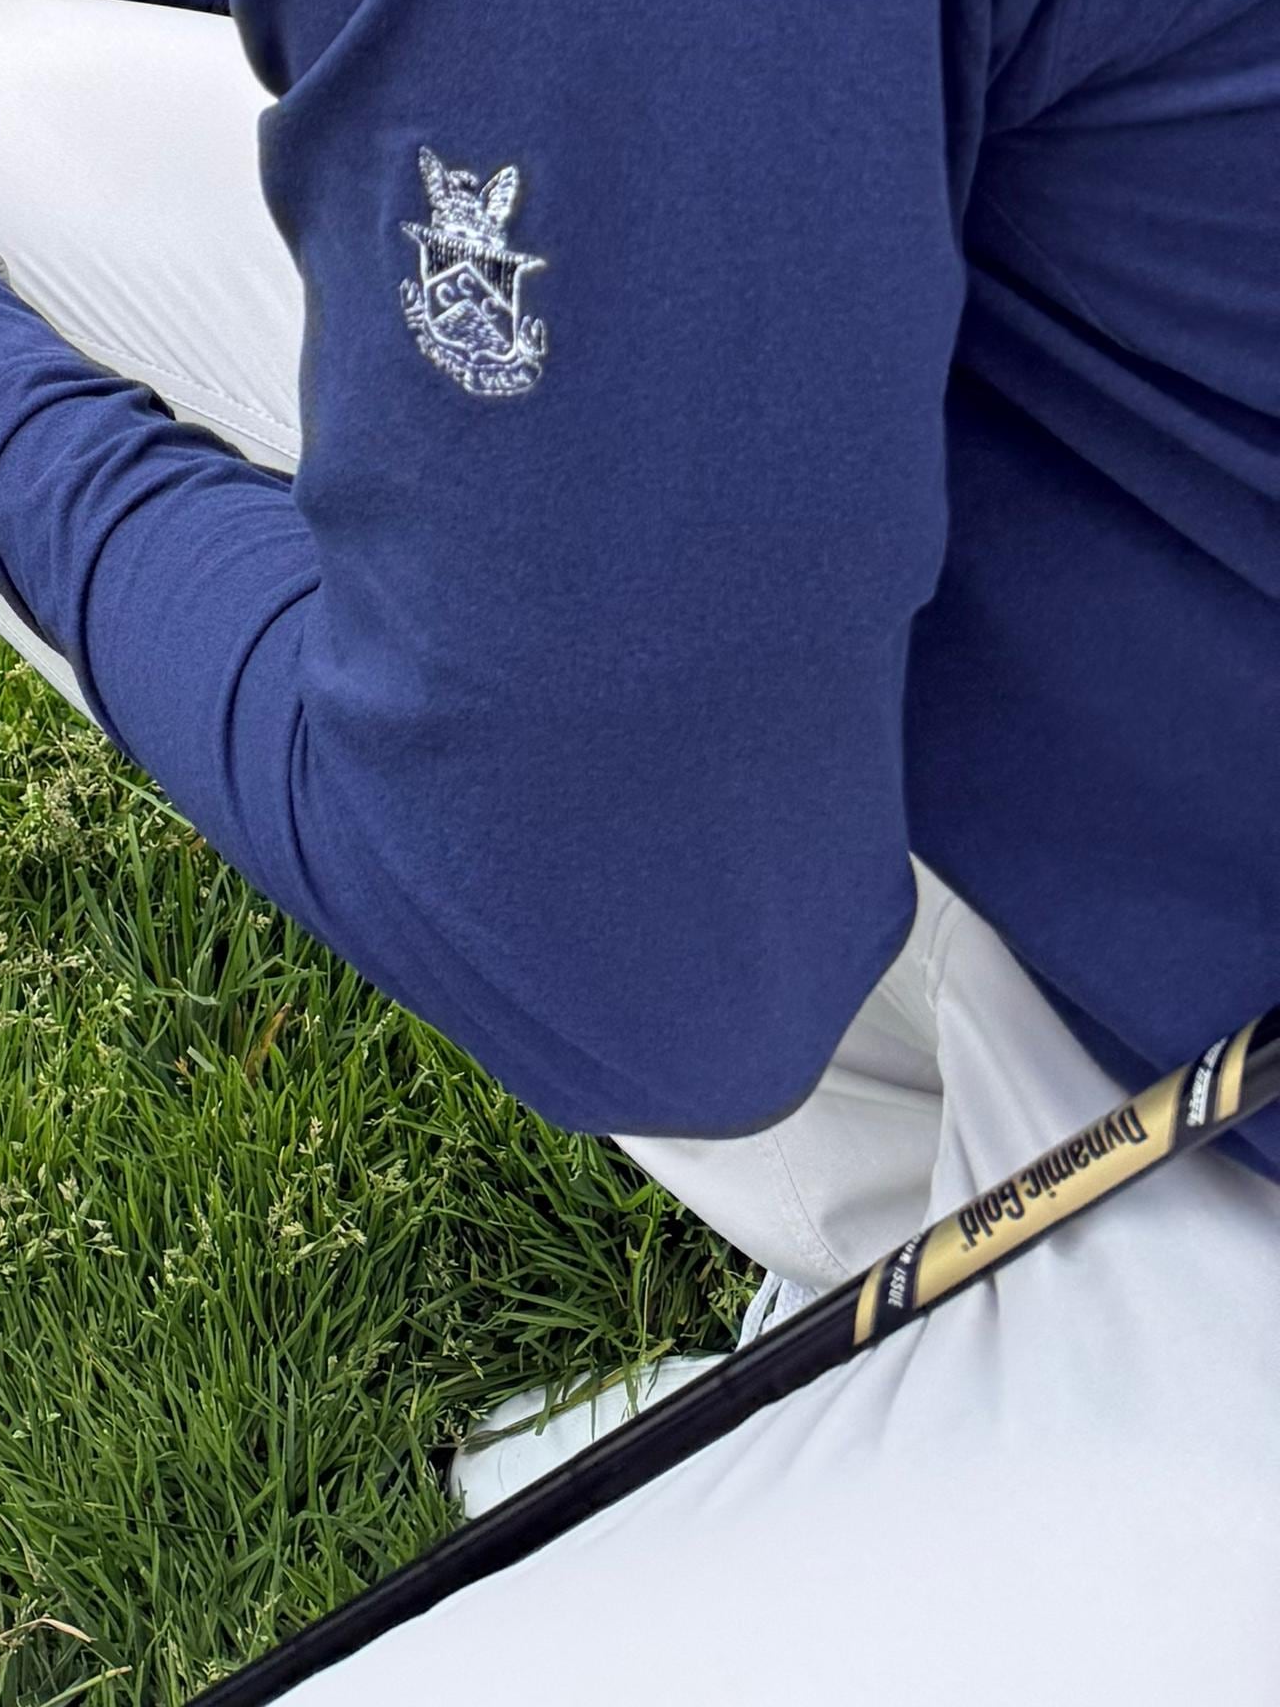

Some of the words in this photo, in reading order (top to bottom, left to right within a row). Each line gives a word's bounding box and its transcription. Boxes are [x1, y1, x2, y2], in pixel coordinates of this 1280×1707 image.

[1025, 1103, 1149, 1198] Dynamic
[957, 1182, 1027, 1248] Gold
[887, 1266, 907, 1308] ISSUE
